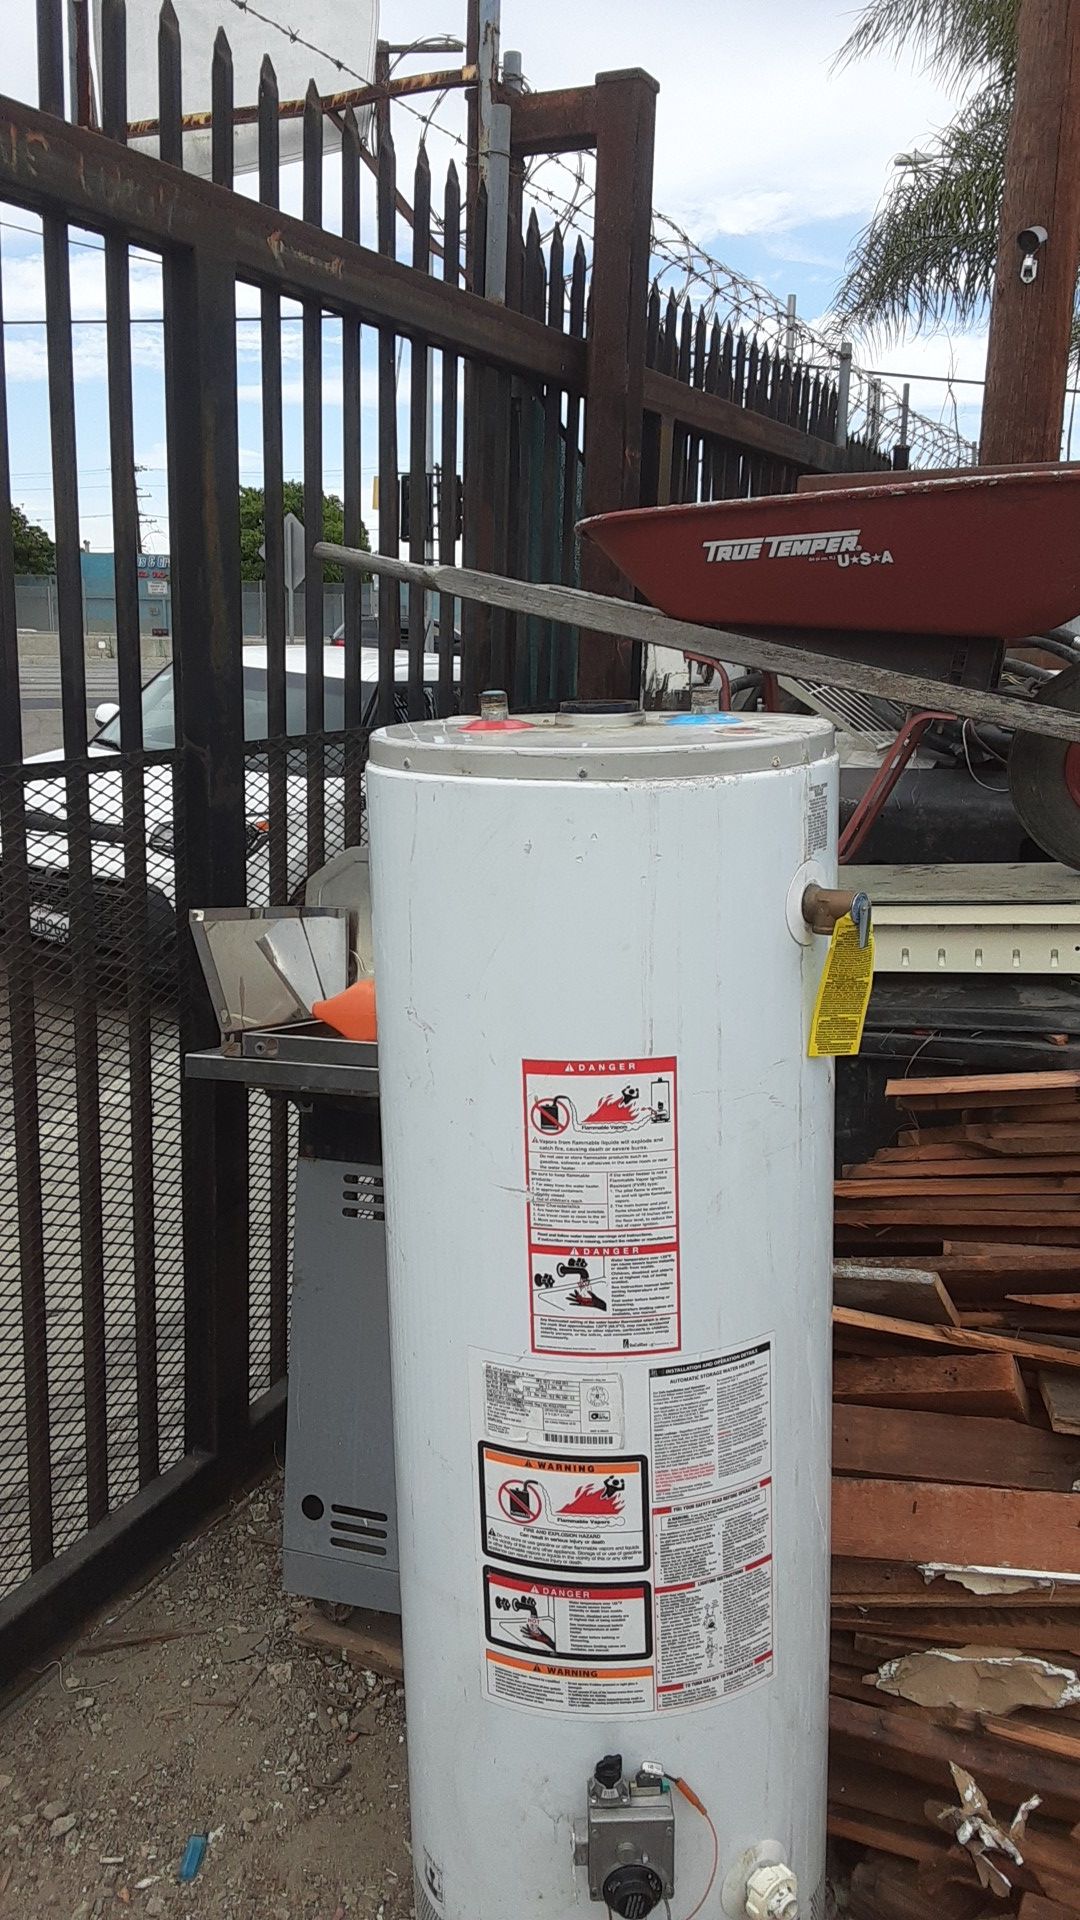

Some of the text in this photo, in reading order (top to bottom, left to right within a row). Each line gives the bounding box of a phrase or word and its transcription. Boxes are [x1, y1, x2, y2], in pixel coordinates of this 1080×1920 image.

[703, 537, 764, 562] TRUE
[764, 529, 861, 558] TEMPER
[578, 1063, 635, 1072] DANGER
[584, 1247, 639, 1255] DANGER
[670, 1360, 755, 1384] AUTOMATIC STORAGE WATER HEATER
[538, 1461, 595, 1473] WARNING
[543, 1588, 590, 1598] DANGER
[547, 1667, 598, 1678] WARNING
